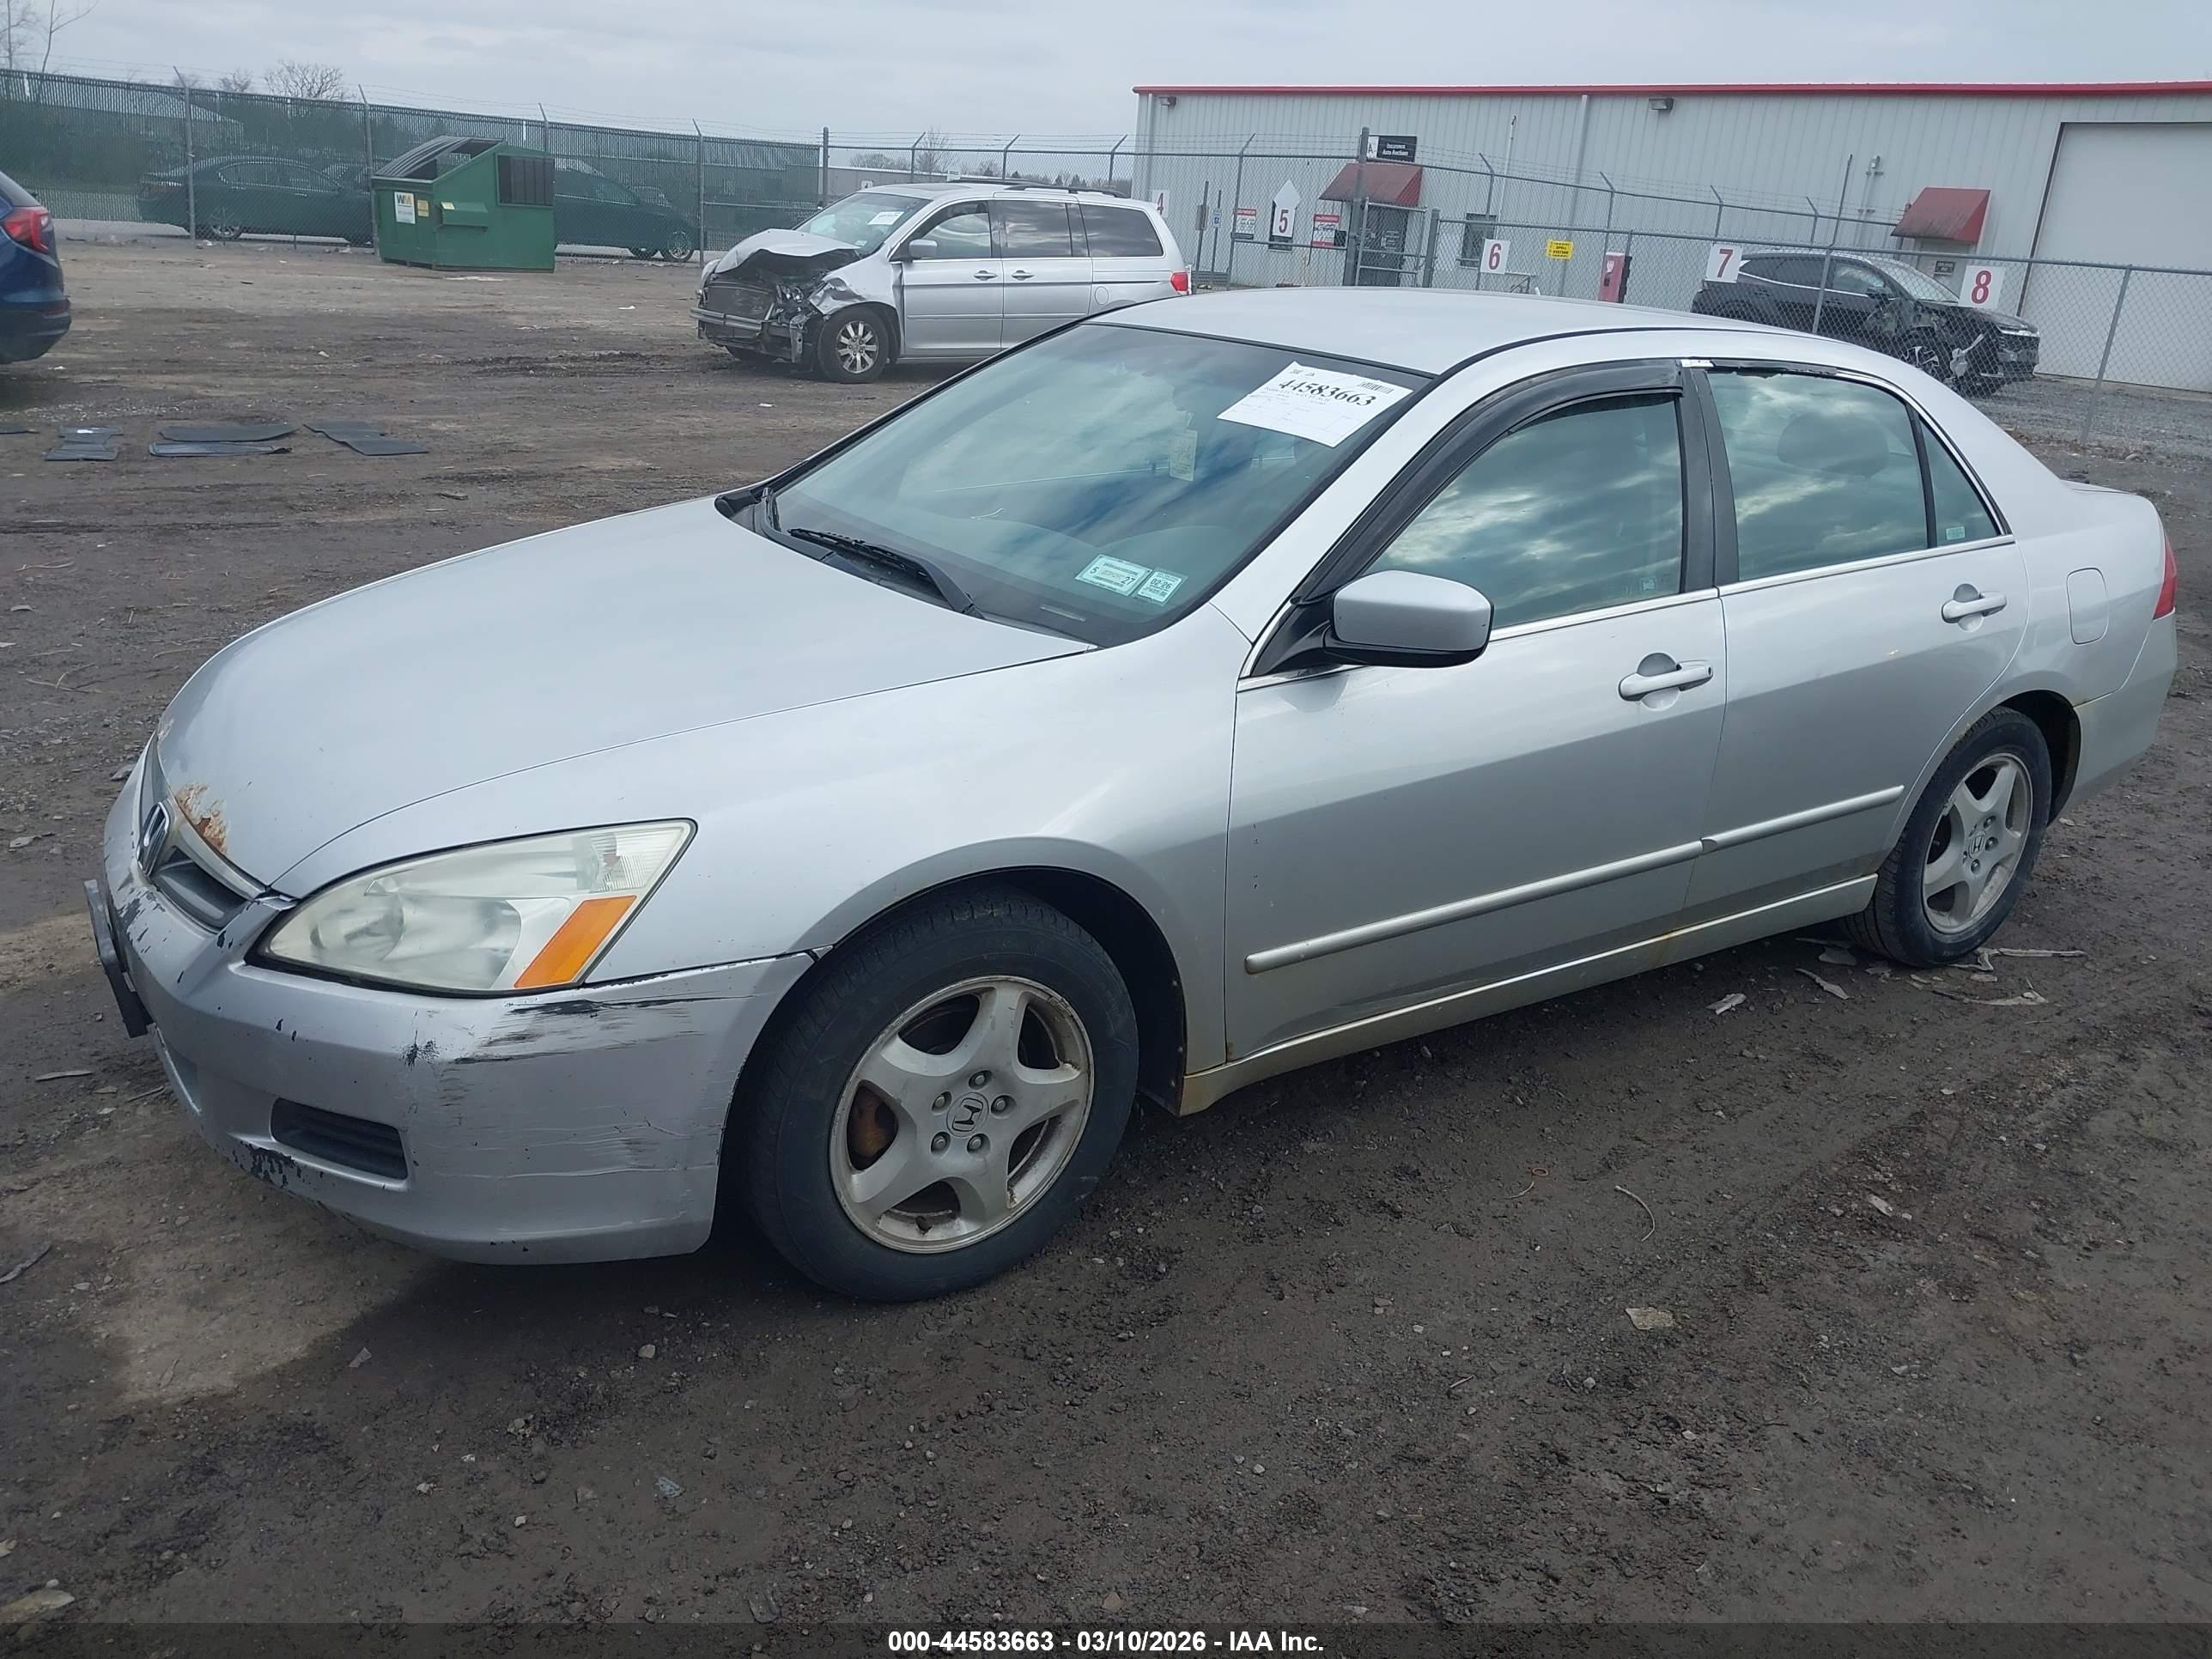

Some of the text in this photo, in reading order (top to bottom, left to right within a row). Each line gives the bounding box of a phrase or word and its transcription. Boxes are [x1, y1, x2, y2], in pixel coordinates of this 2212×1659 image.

[1157, 192, 1164, 216] 4
[1279, 209, 1290, 234] 5
[1488, 242, 1502, 270] 6
[1717, 248, 1733, 278] 7
[1971, 270, 1992, 305] 8
[1279, 379, 1377, 407] 44583663
[1090, 566, 1100, 574] 5
[1121, 576, 1136, 586] 27
